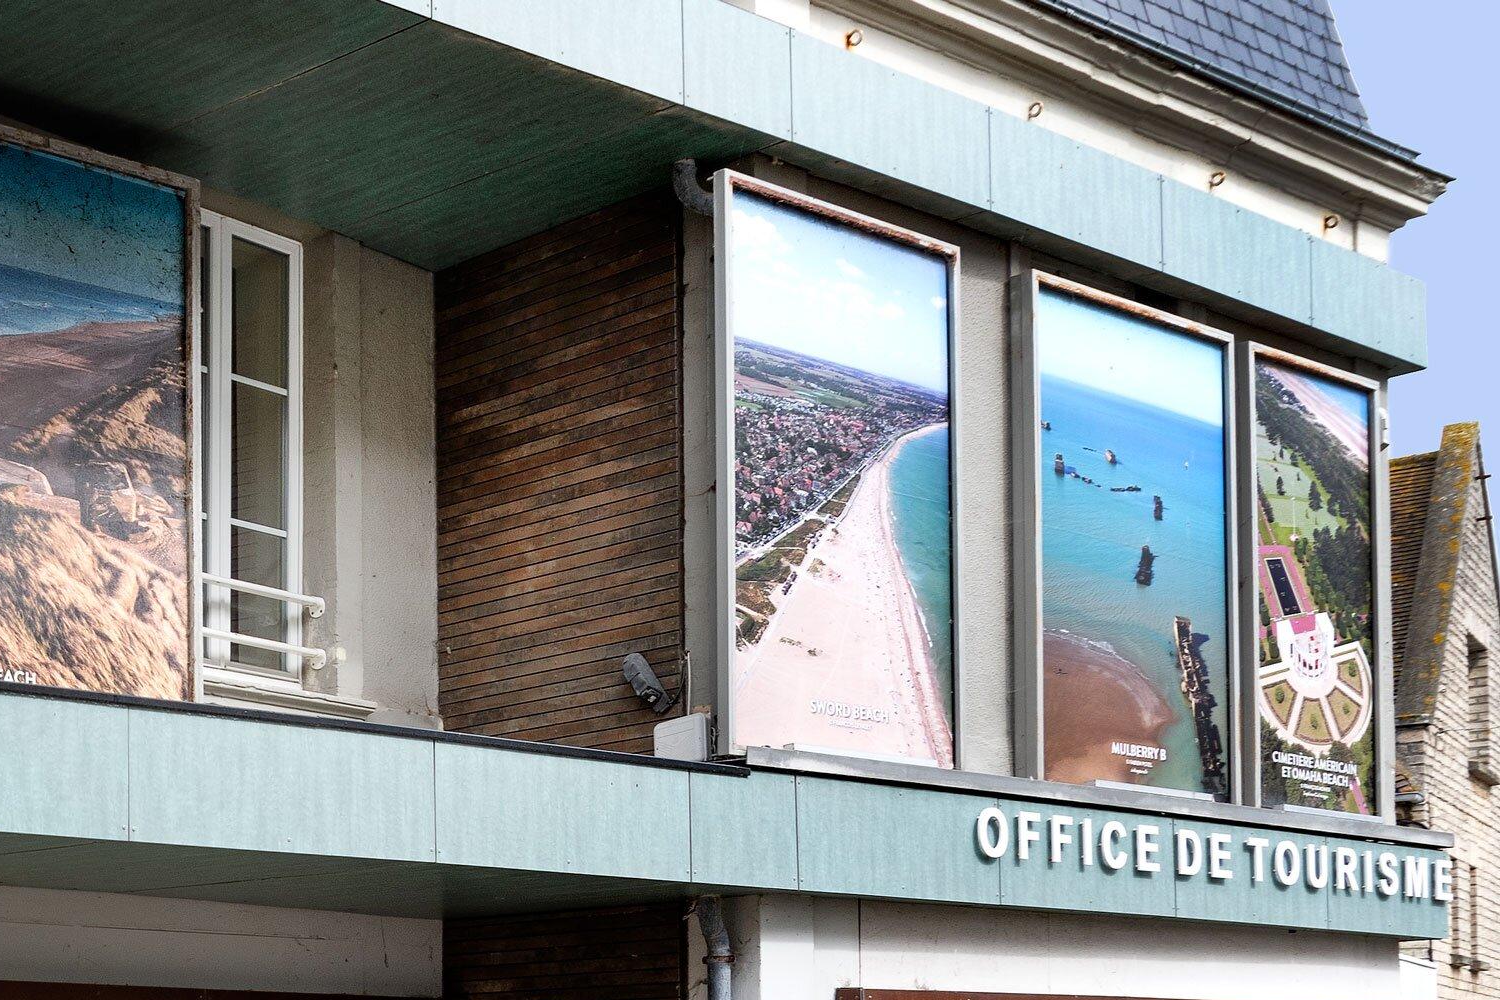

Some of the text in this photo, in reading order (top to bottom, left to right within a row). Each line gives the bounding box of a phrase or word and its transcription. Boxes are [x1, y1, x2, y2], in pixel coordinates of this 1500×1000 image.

[810, 700, 889, 724] SWORD BEACH
[1111, 742, 1167, 761] MULBERRY B
[1281, 766, 1349, 787] ET OMAHA BEACH
[975, 806, 1454, 902] OFFICE DE TOURISME
